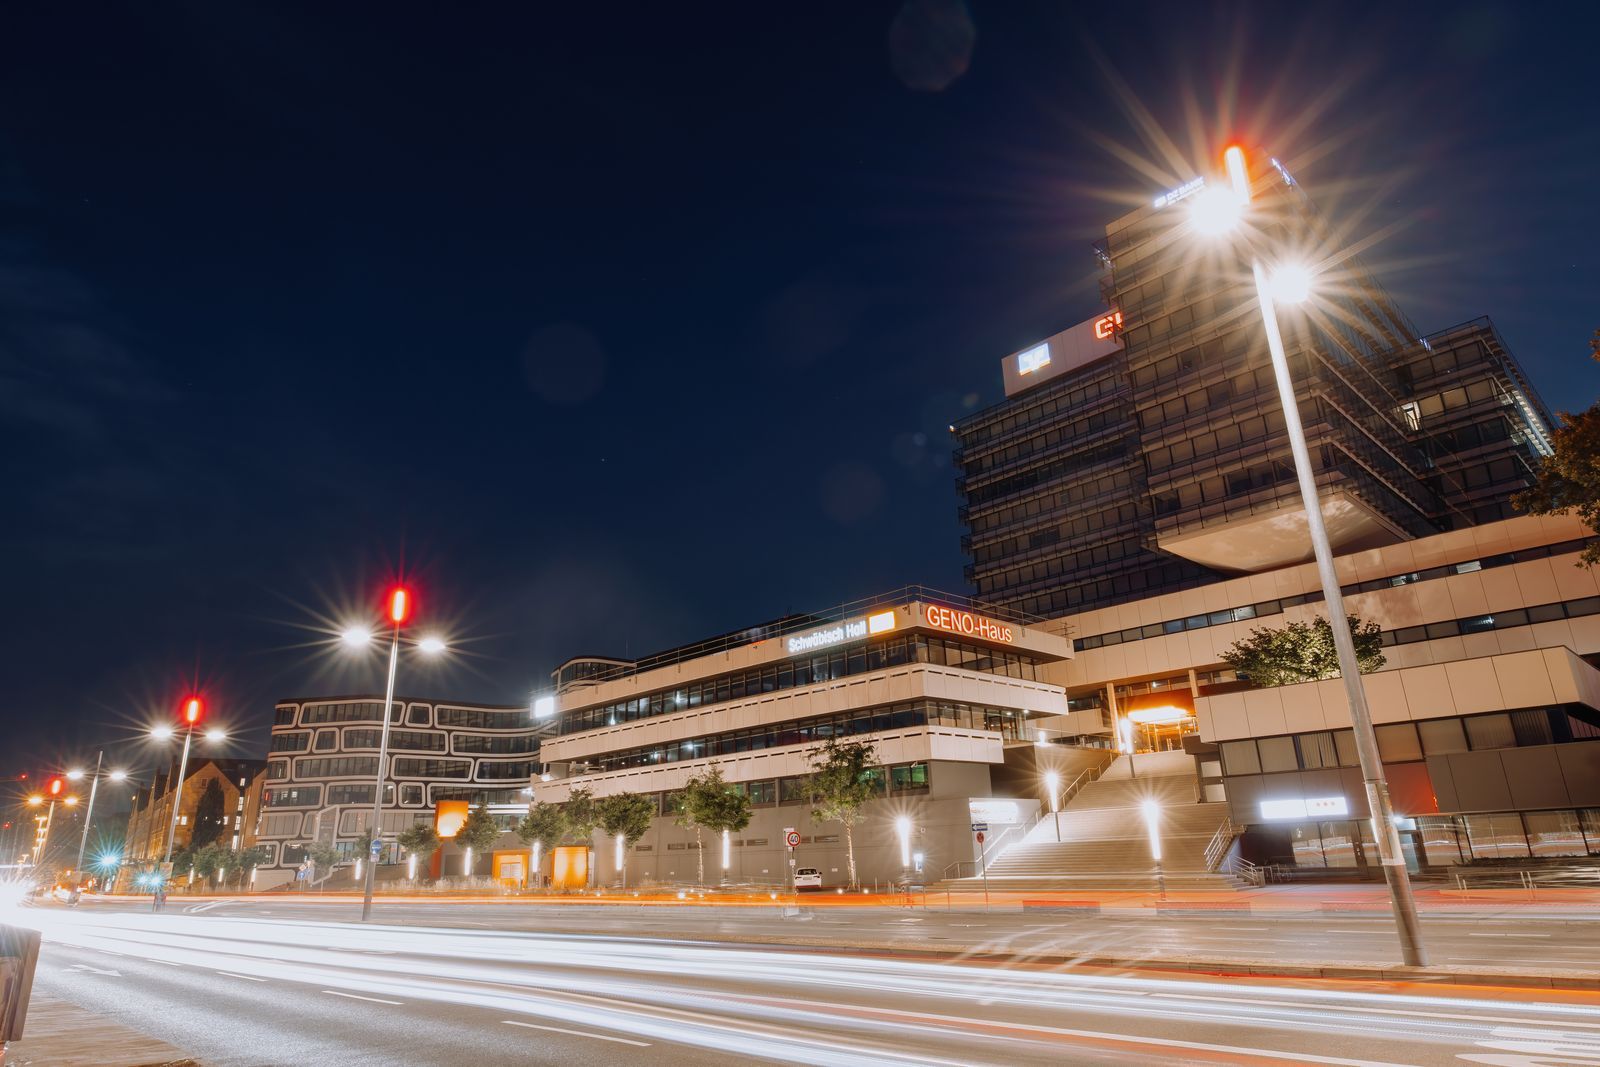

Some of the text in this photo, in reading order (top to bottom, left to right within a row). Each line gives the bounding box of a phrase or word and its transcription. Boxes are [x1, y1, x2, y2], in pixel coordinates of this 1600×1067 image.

[788, 620, 867, 653] Schwäbisch Hall
[927, 605, 1013, 643] GENO-Haus
[791, 835, 799, 843] 40
